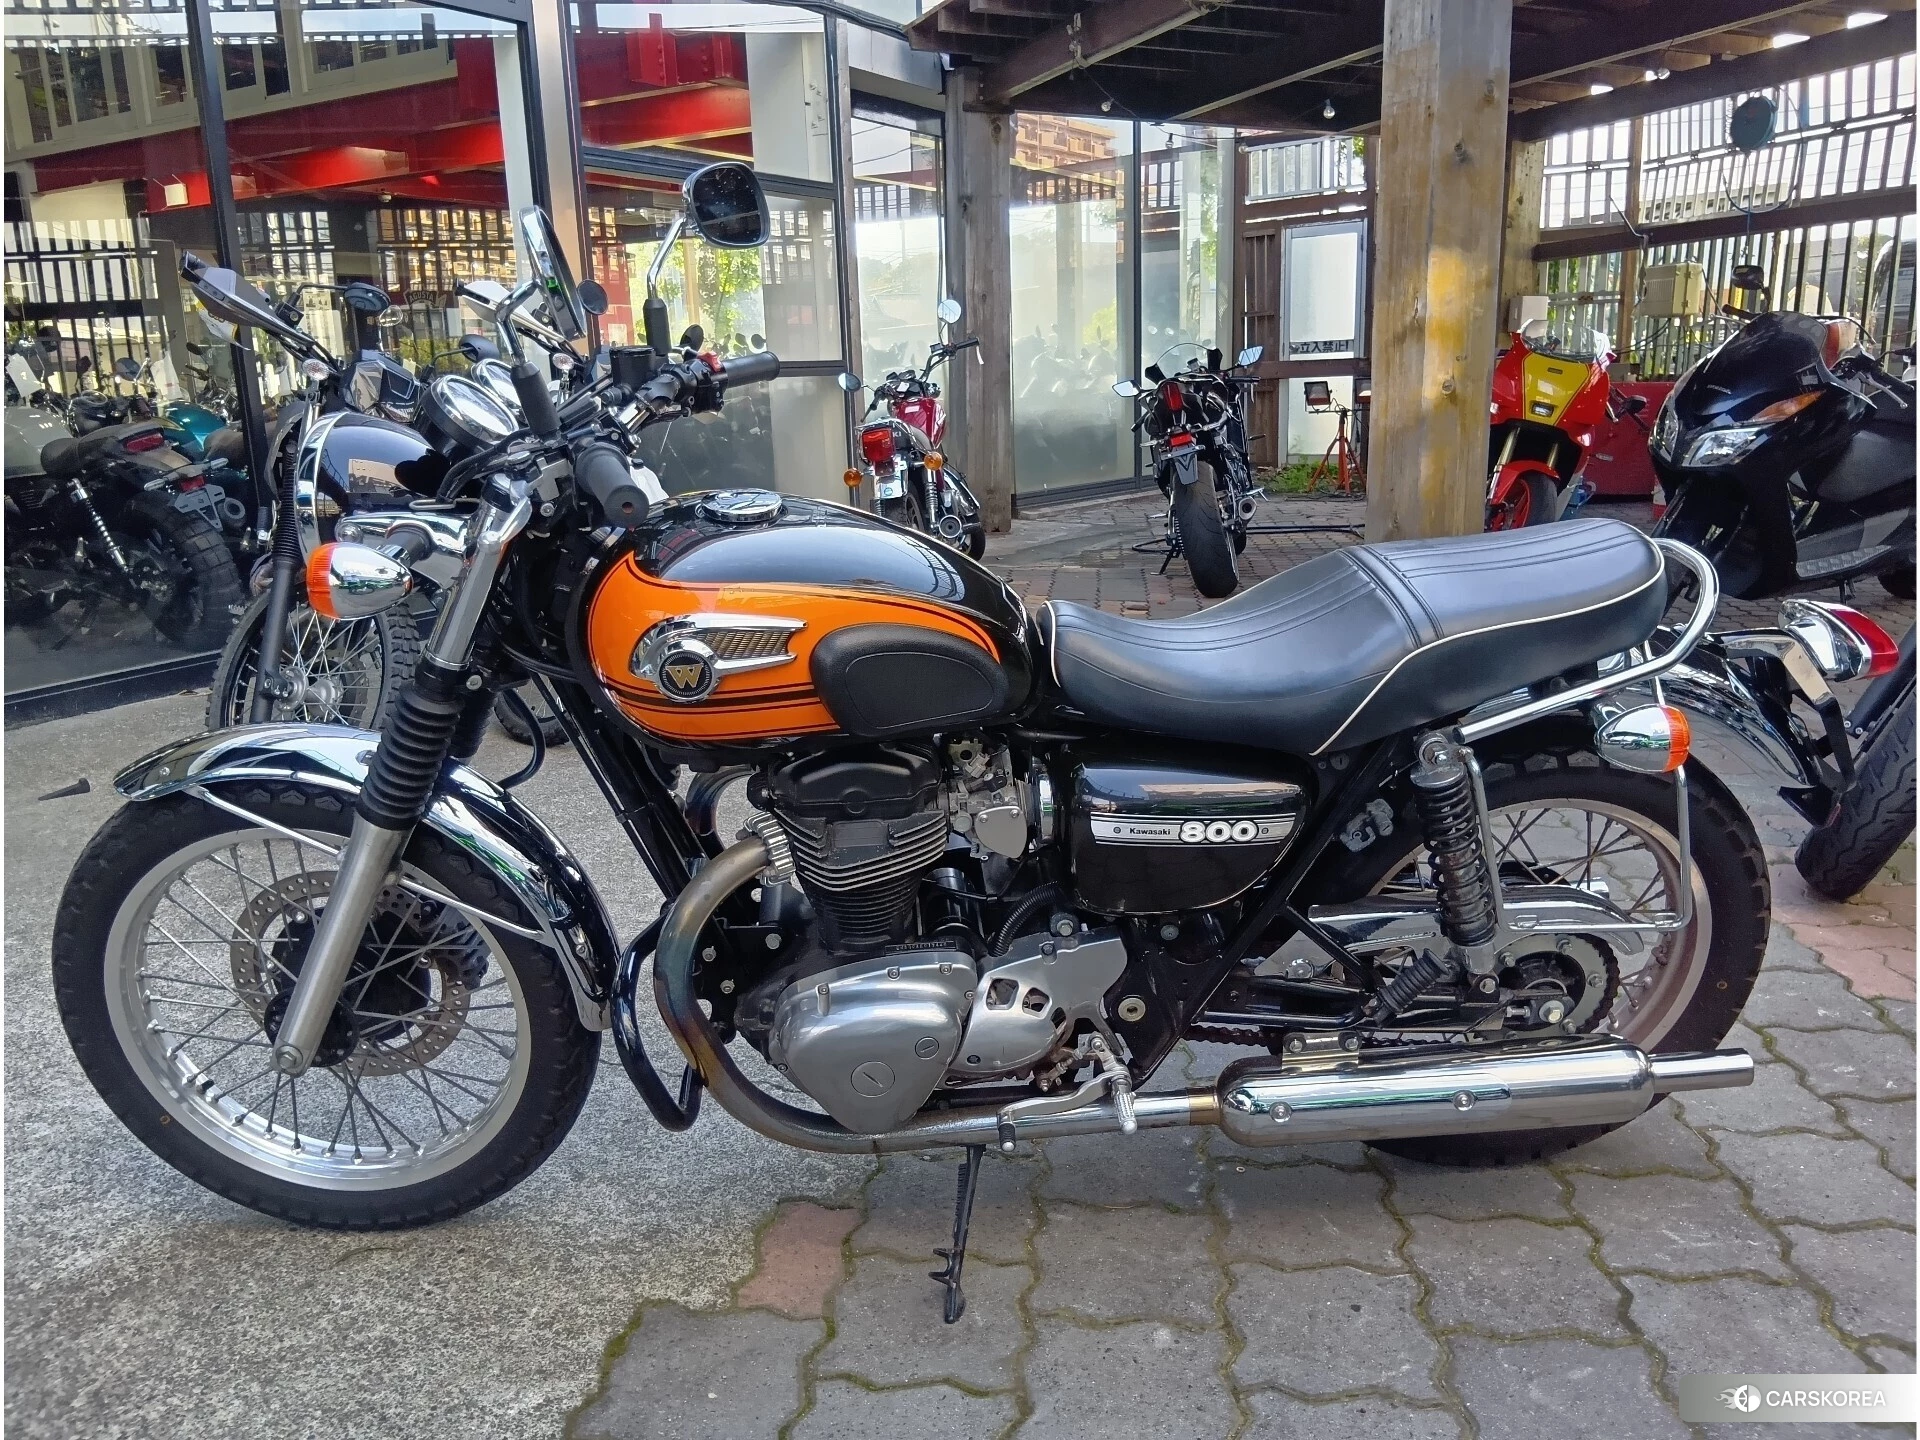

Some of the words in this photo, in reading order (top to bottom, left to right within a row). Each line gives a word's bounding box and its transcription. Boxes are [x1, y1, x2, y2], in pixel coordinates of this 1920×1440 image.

[409, 291, 434, 303] AGUSTA
[666, 663, 704, 689] W
[1129, 827, 1171, 836] Kawasaki
[1179, 820, 1259, 843] 800
